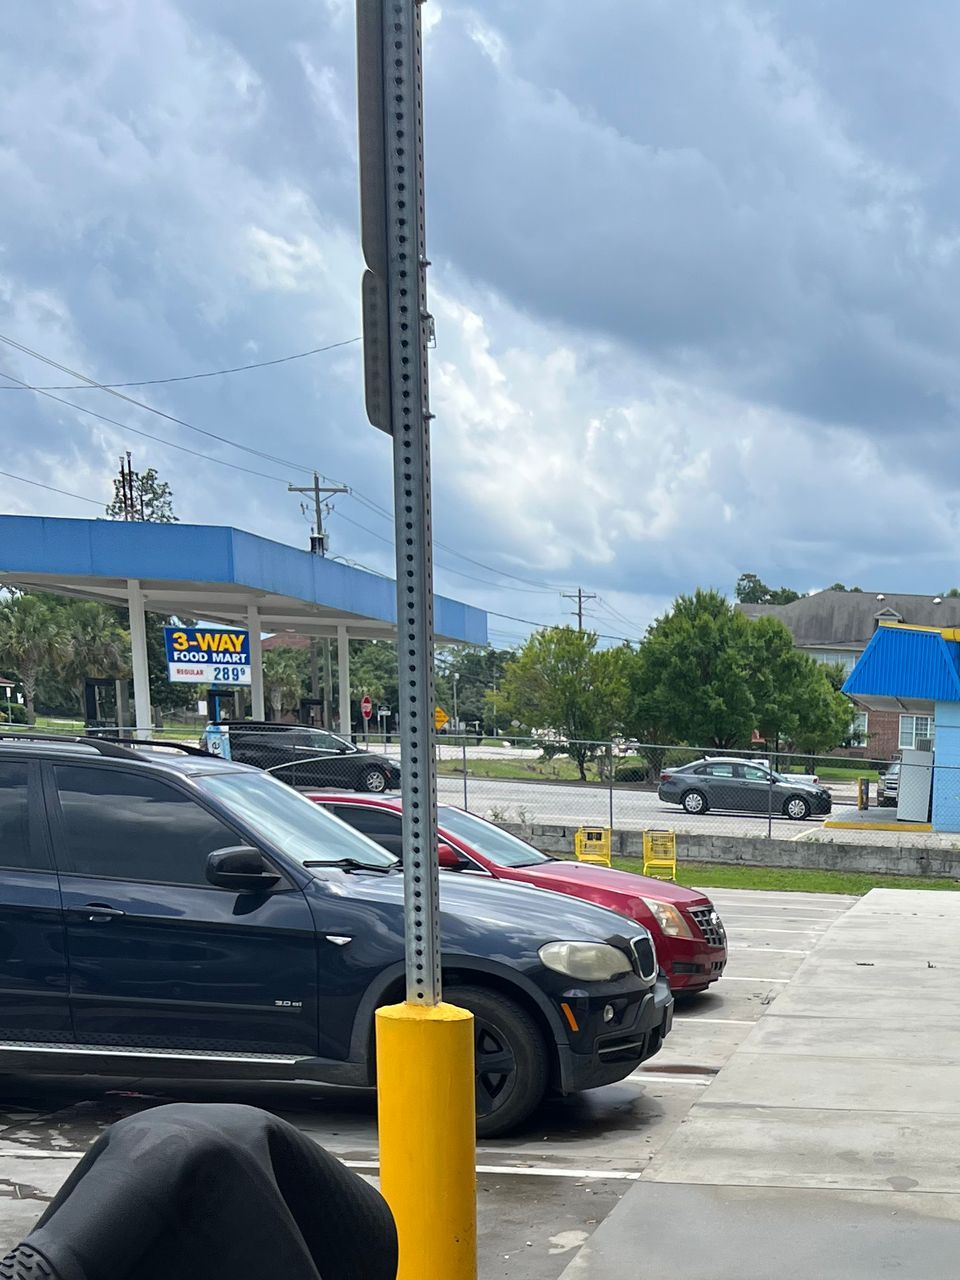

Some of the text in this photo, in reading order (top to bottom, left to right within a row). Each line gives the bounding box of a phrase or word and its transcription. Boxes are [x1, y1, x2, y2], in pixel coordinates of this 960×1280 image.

[172, 631, 246, 652] 3-WAY
[173, 651, 247, 663] FOOD MART
[176, 668, 204, 676] REGULAR
